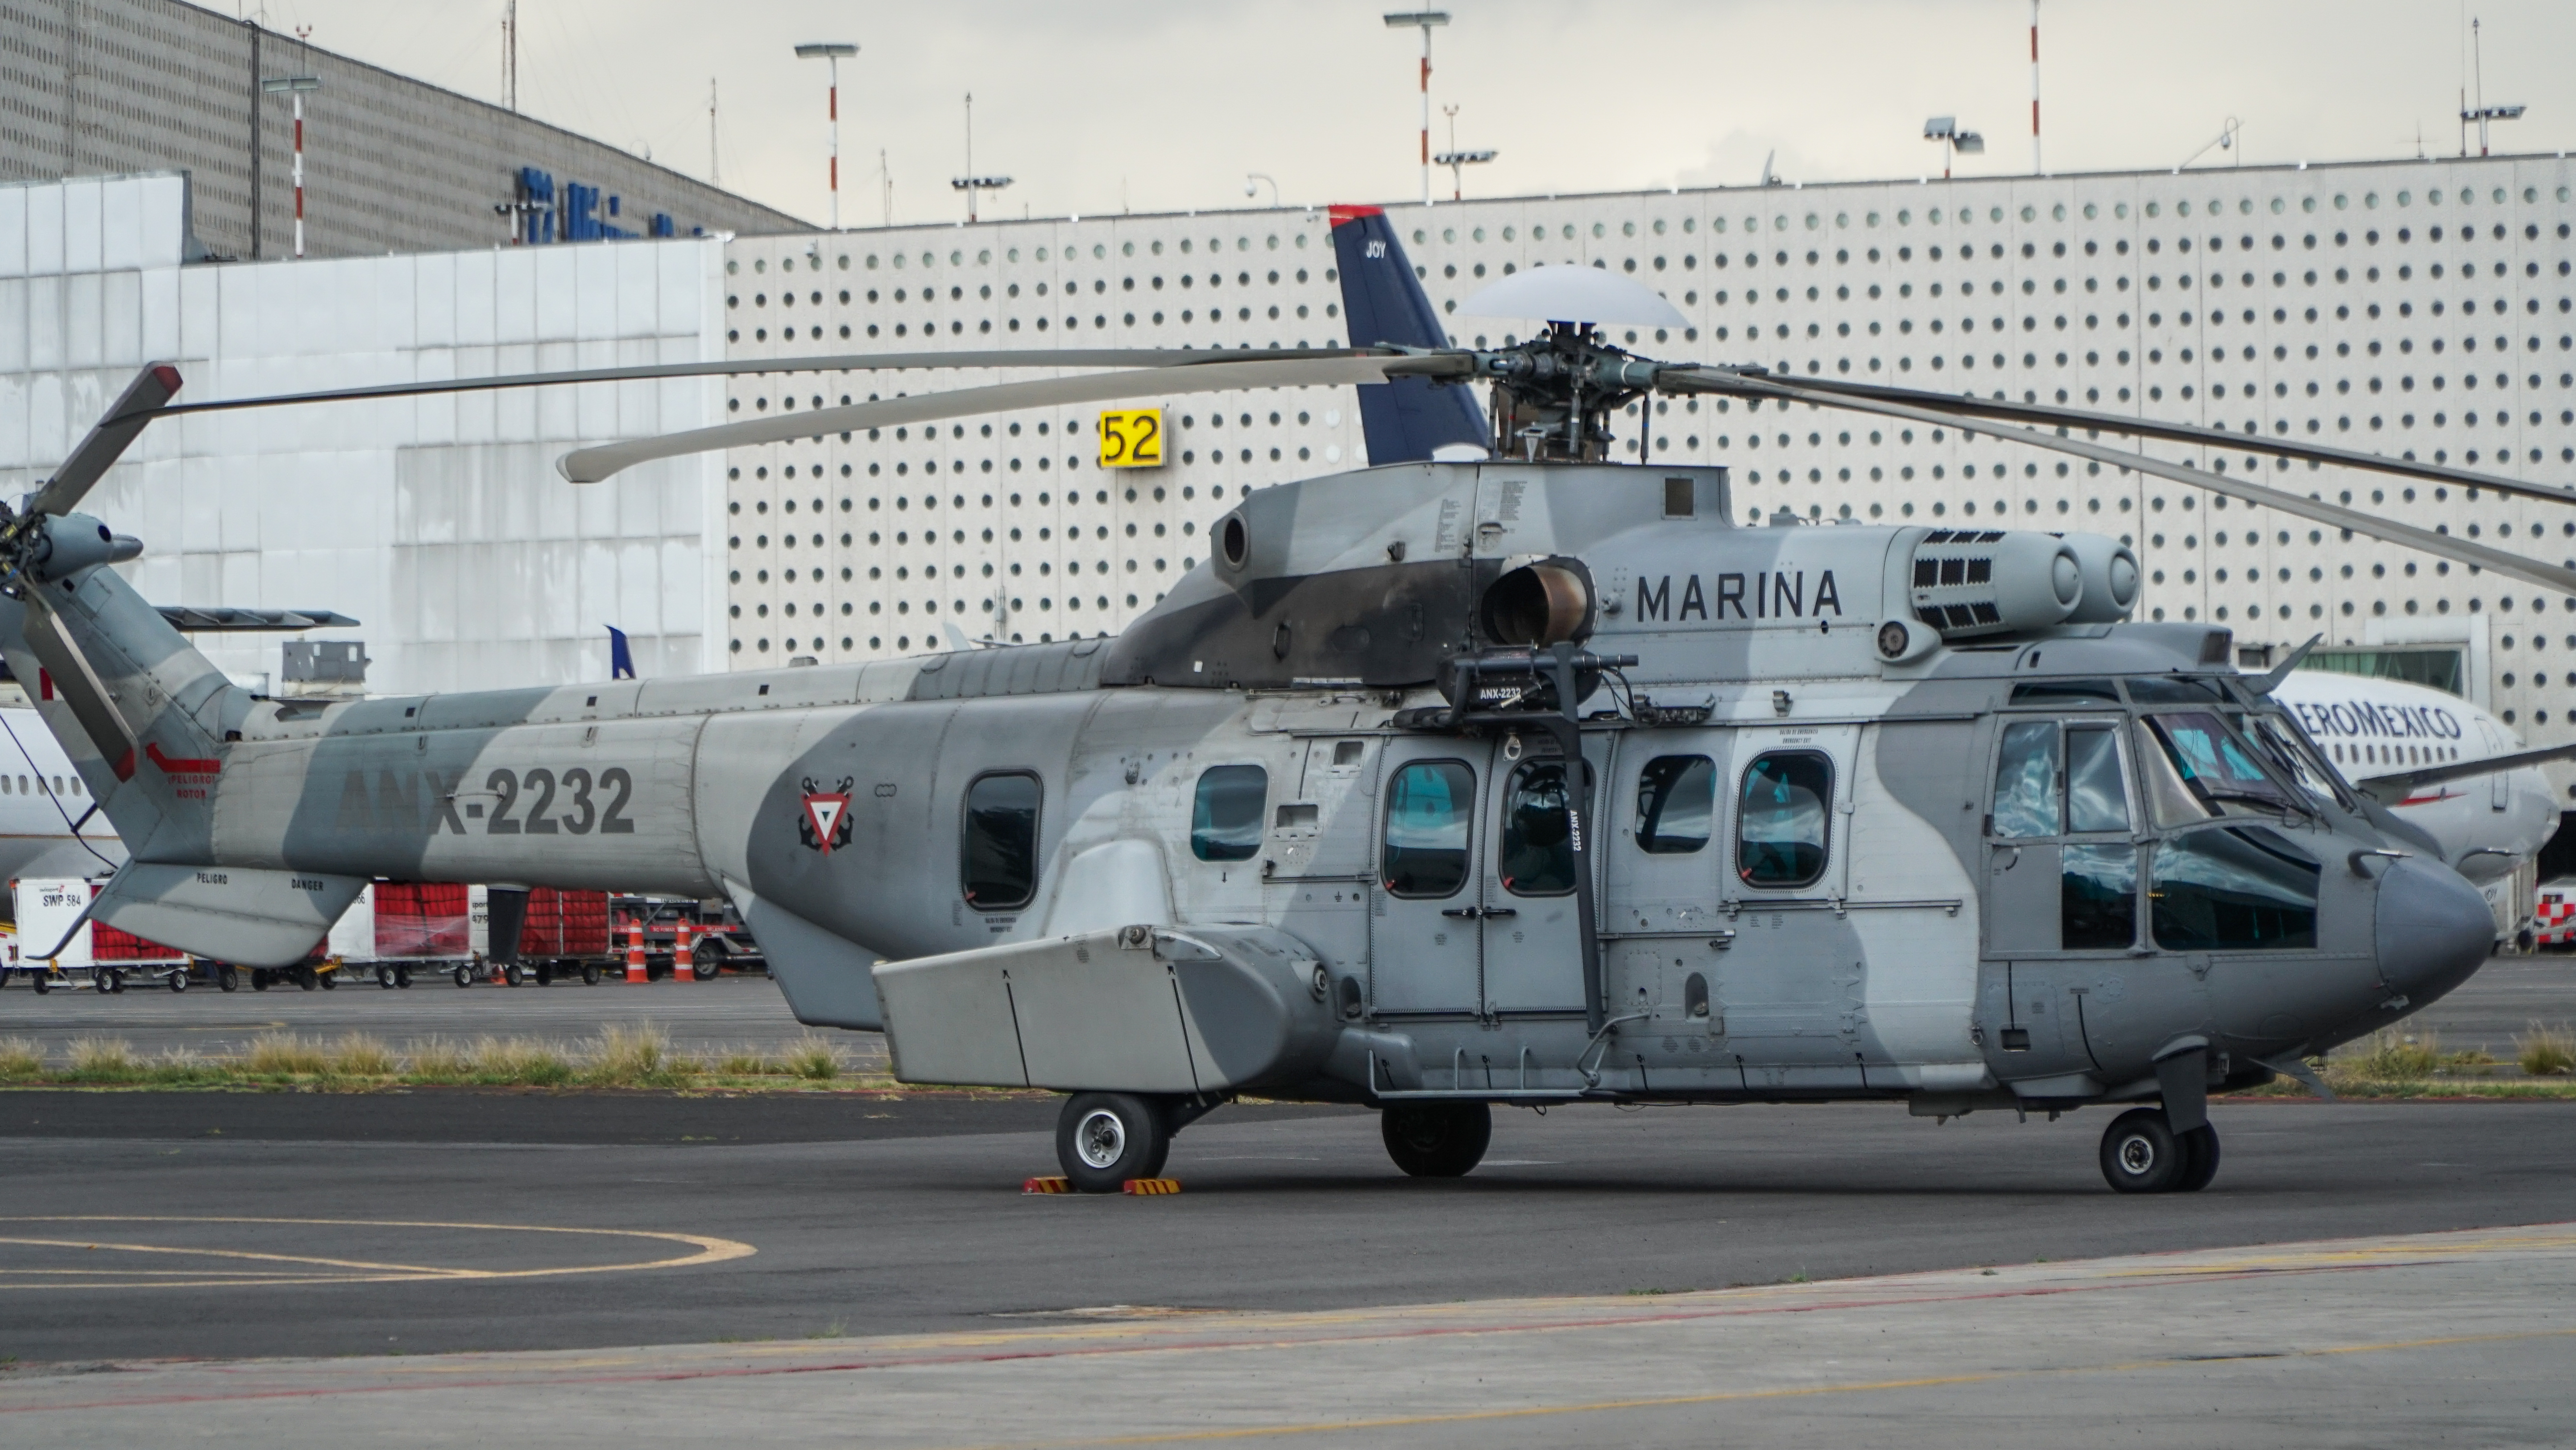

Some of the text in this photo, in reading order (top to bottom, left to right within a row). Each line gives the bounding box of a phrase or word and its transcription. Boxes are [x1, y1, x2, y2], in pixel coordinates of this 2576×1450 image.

[1366, 241, 1386, 258] JOY
[1105, 416, 1159, 463] 52
[1638, 569, 1842, 622] MARINA
[1480, 688, 1521, 699] ANX-2232
[177, 789, 206, 798] ROTOR
[335, 767, 635, 835] ANX-2232
[1570, 810, 1582, 852] ANX-2232
[197, 872, 228, 885] PELIGRO
[291, 877, 323, 891] DANGER
[43, 894, 81, 906] SWP 584
[353, 893, 365, 904] 66
